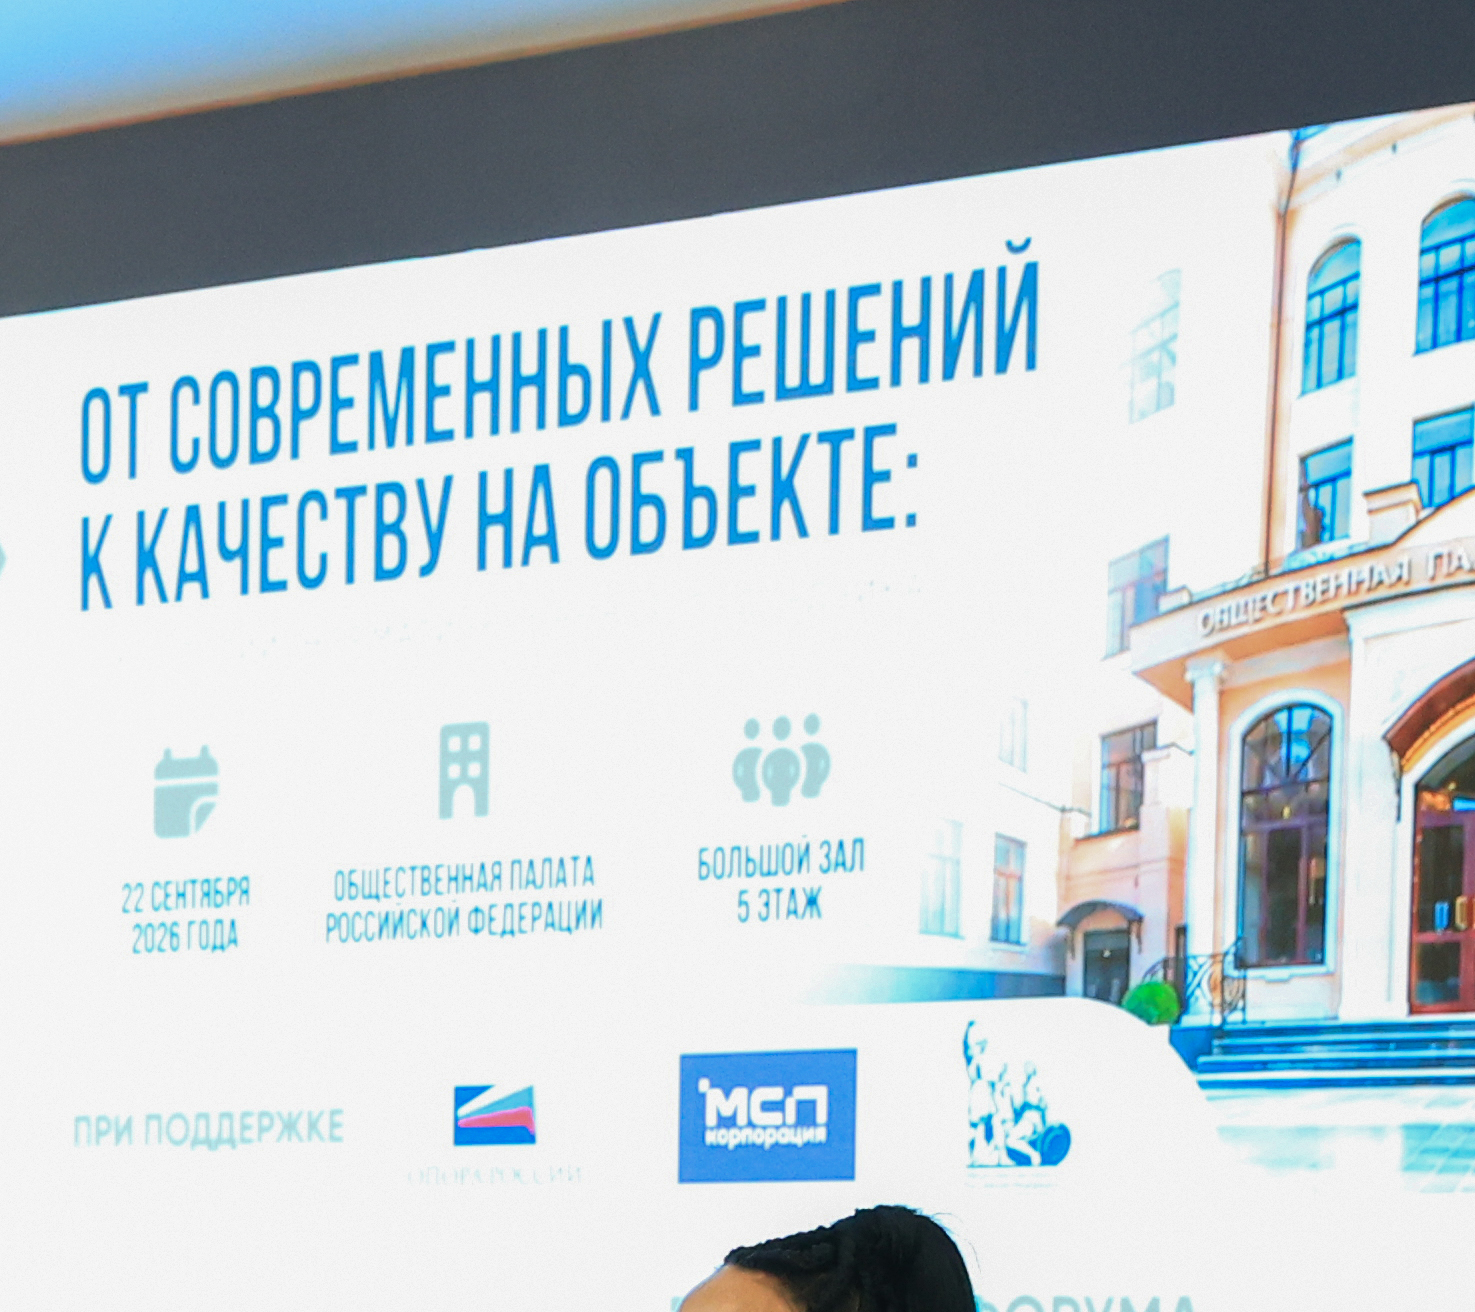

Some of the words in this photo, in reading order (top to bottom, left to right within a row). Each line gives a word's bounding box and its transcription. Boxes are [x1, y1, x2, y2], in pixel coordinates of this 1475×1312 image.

[79, 380, 149, 485] ОТ
[169, 312, 662, 474] СОВРЕМЕННЫХ
[687, 237, 1040, 411] РЕШЕНИЙ
[80, 513, 113, 611] К
[136, 474, 453, 606] КАЧЕСТВУ
[476, 462, 560, 572] НА
[584, 423, 920, 560] ОБЪЕКТЕ:
[334, 860, 503, 903] ОБЩЕСТВЕННАЯ
[509, 854, 595, 891] ПАЛАТА
[697, 834, 811, 881] БОЛЬШОЙ
[818, 836, 866, 875] ЗАЛ
[121, 882, 145, 914] 22
[151, 874, 251, 912] СЕНТЯБРЯ
[737, 888, 750, 924] 5
[757, 884, 823, 923] ЭТАЖ
[132, 920, 180, 954] 2026
[187, 918, 239, 953] ГОДА
[325, 900, 460, 945] РОССИЙСКОЙ
[467, 897, 604, 939] ФЕДЕРАЦИИ
[701, 1079, 828, 1127] МСП
[73, 1113, 134, 1148] ПРИ
[144, 1107, 345, 1152] ПОДДЕРЖКЕ
[705, 1125, 827, 1150] корпорация
